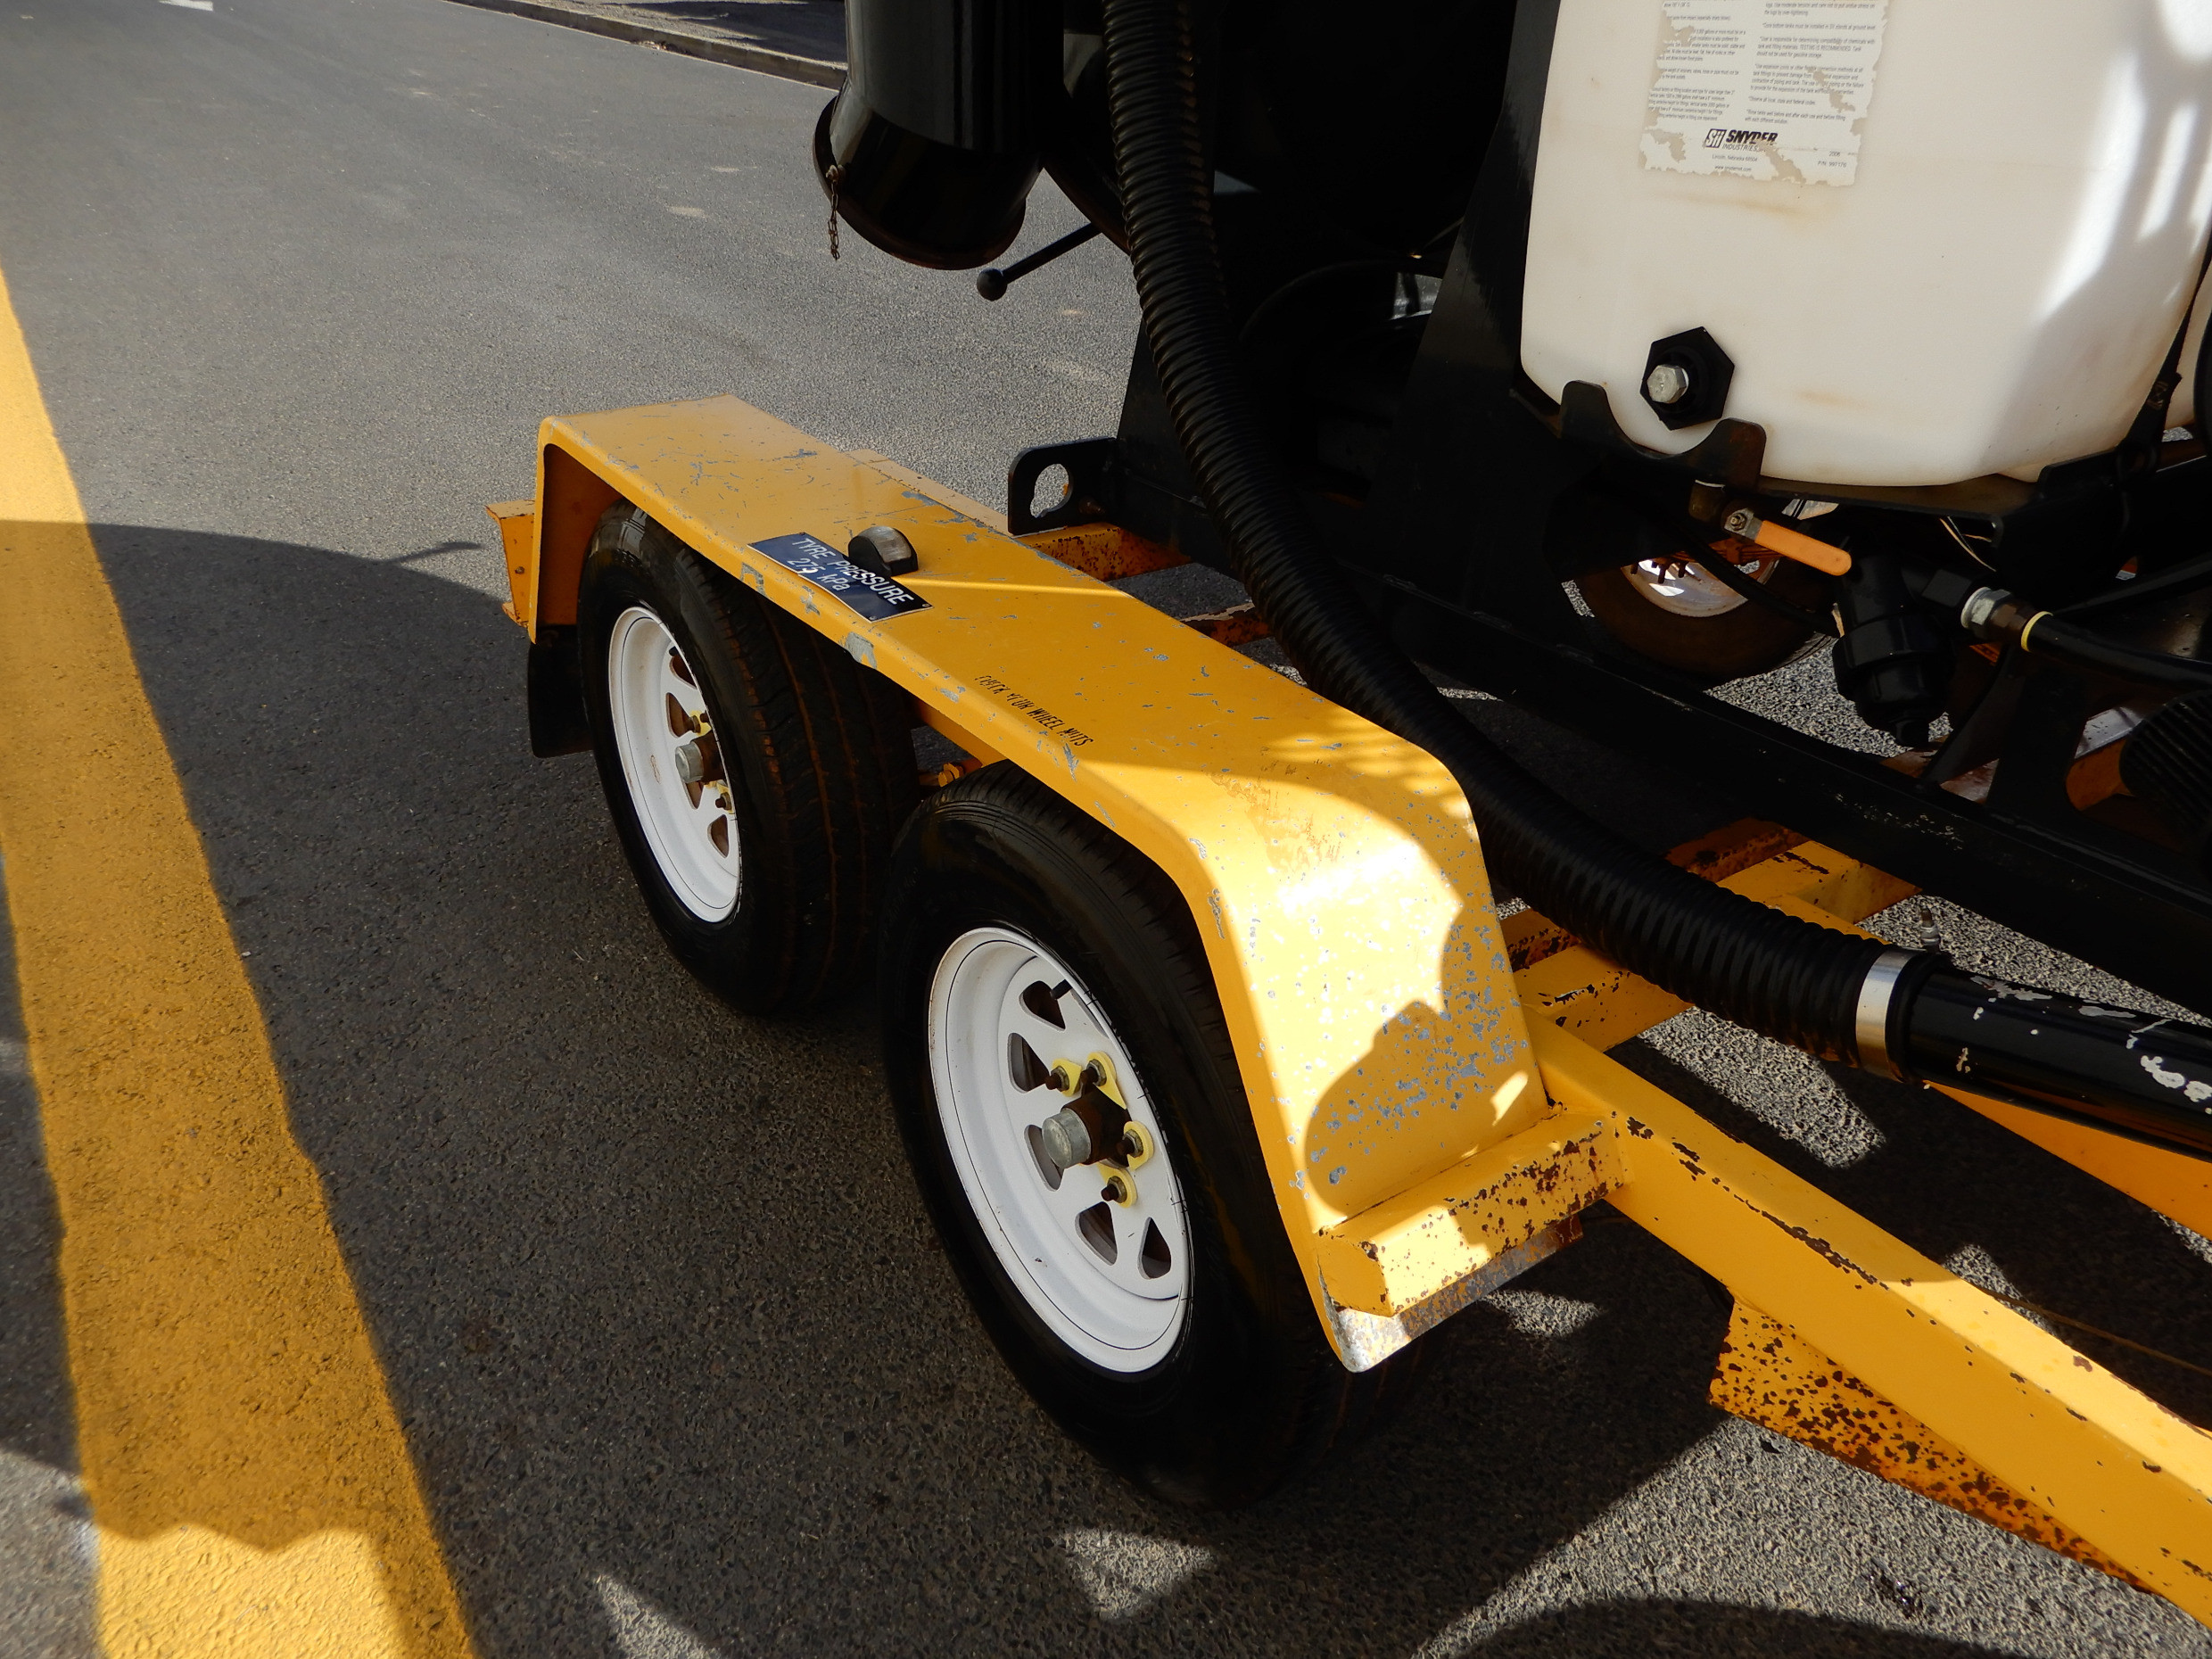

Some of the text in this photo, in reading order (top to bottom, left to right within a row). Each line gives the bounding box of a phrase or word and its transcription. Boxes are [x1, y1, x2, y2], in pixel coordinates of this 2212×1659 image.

[1722, 143, 1758, 152] INDUSTRIES
[1726, 129, 1778, 145] SNYDER
[787, 557, 851, 592] 275 kPa
[792, 538, 915, 605] TYRE PRESSURE
[1026, 707, 1065, 730] WHEEL
